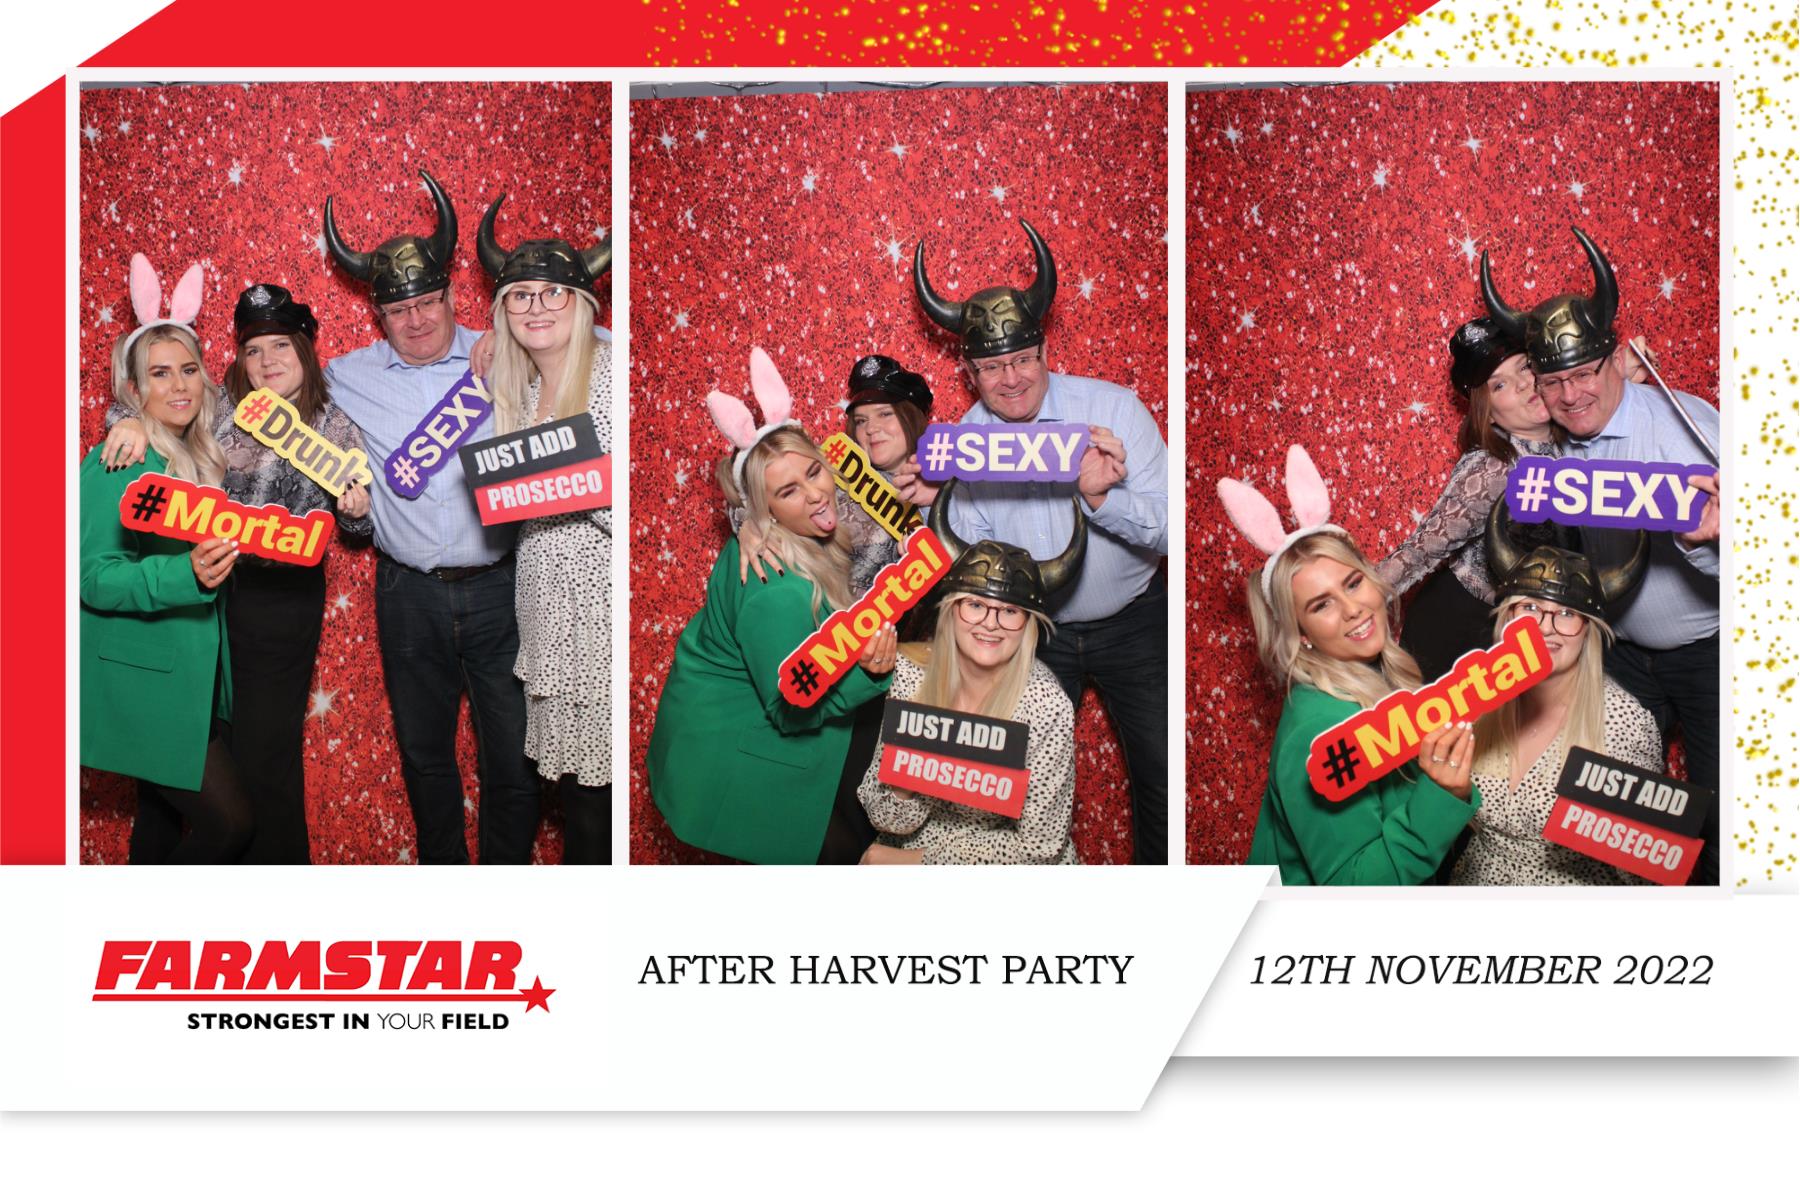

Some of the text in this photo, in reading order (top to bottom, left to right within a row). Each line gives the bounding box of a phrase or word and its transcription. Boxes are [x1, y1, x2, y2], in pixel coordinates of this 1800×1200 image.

[240, 393, 365, 490] #Drunk
[392, 374, 495, 489] #SEXY
[474, 425, 577, 475] JUST ADD
[925, 432, 1082, 473] #SEXY
[487, 469, 604, 511] PROSECCO
[825, 439, 923, 534] #Drunk
[1516, 467, 1700, 521] #SEXY
[131, 484, 325, 559] #Mortal
[790, 538, 943, 698] #Mortal
[896, 710, 1007, 751] JUST ADD
[1322, 628, 1541, 789] #Mortal
[892, 750, 1013, 801] PROSECCO
[1575, 761, 1689, 817] JUST ADD
[1560, 804, 1684, 872] PROSECCO
